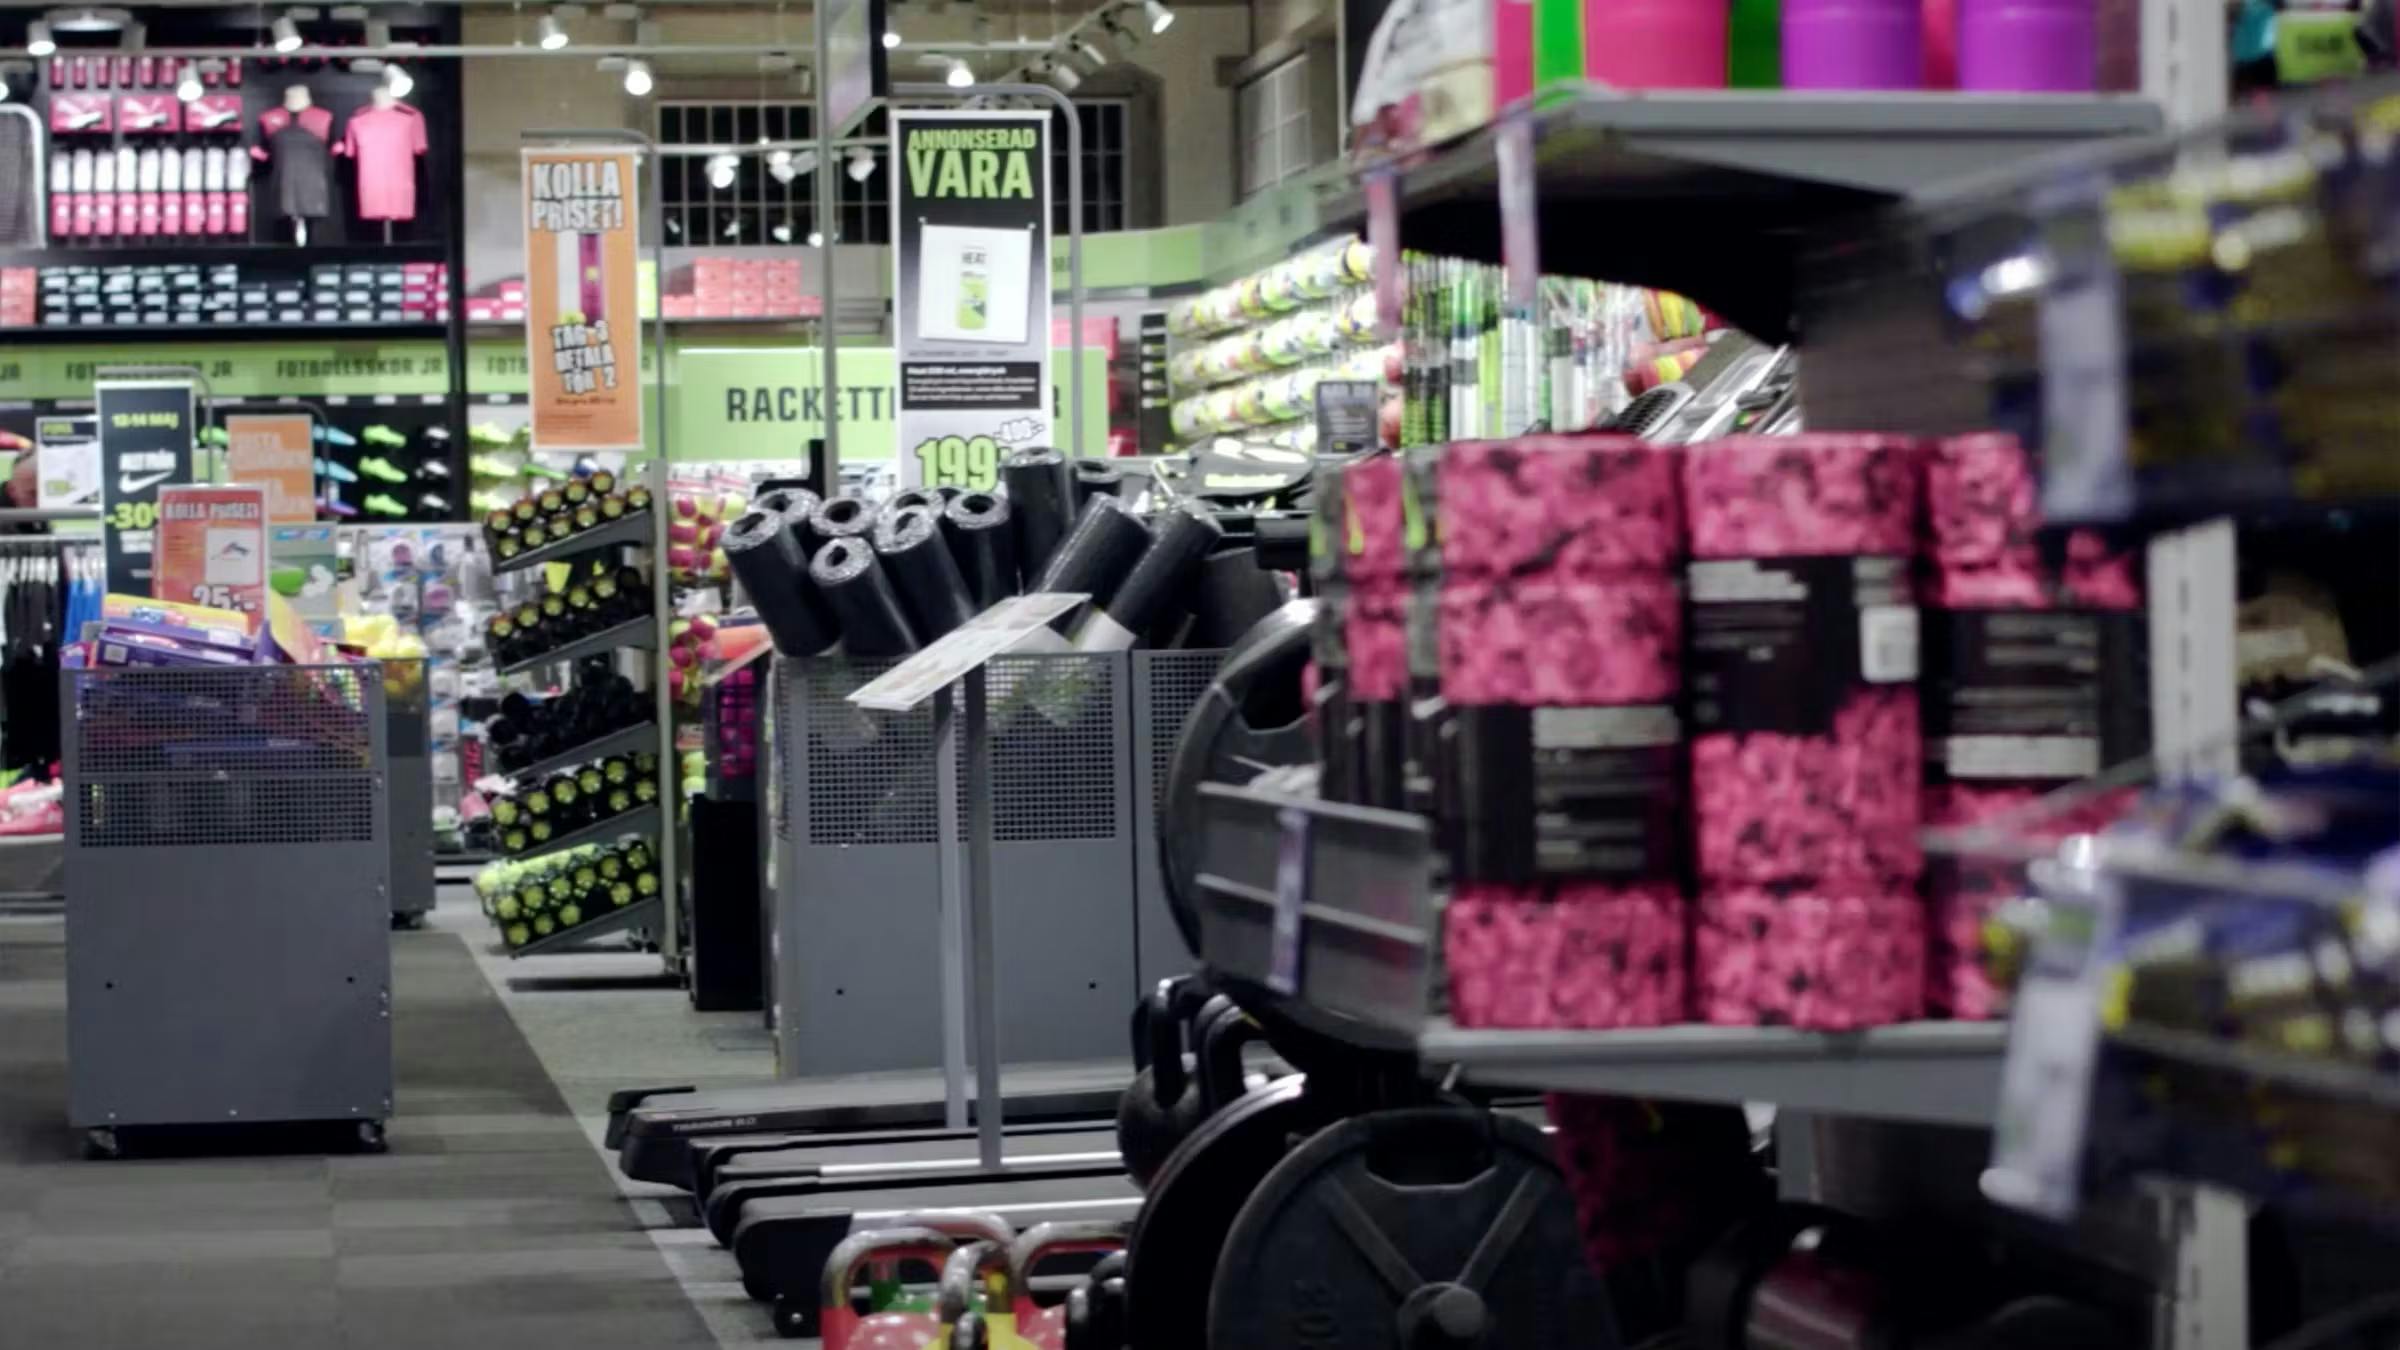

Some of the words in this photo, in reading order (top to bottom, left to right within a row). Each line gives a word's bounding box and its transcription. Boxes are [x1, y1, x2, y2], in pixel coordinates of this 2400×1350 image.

[908, 128, 1037, 150] ANNONSERAD
[531, 161, 620, 200] KOLLA
[907, 149, 1035, 199] VARA
[531, 198, 625, 232] PRISET!
